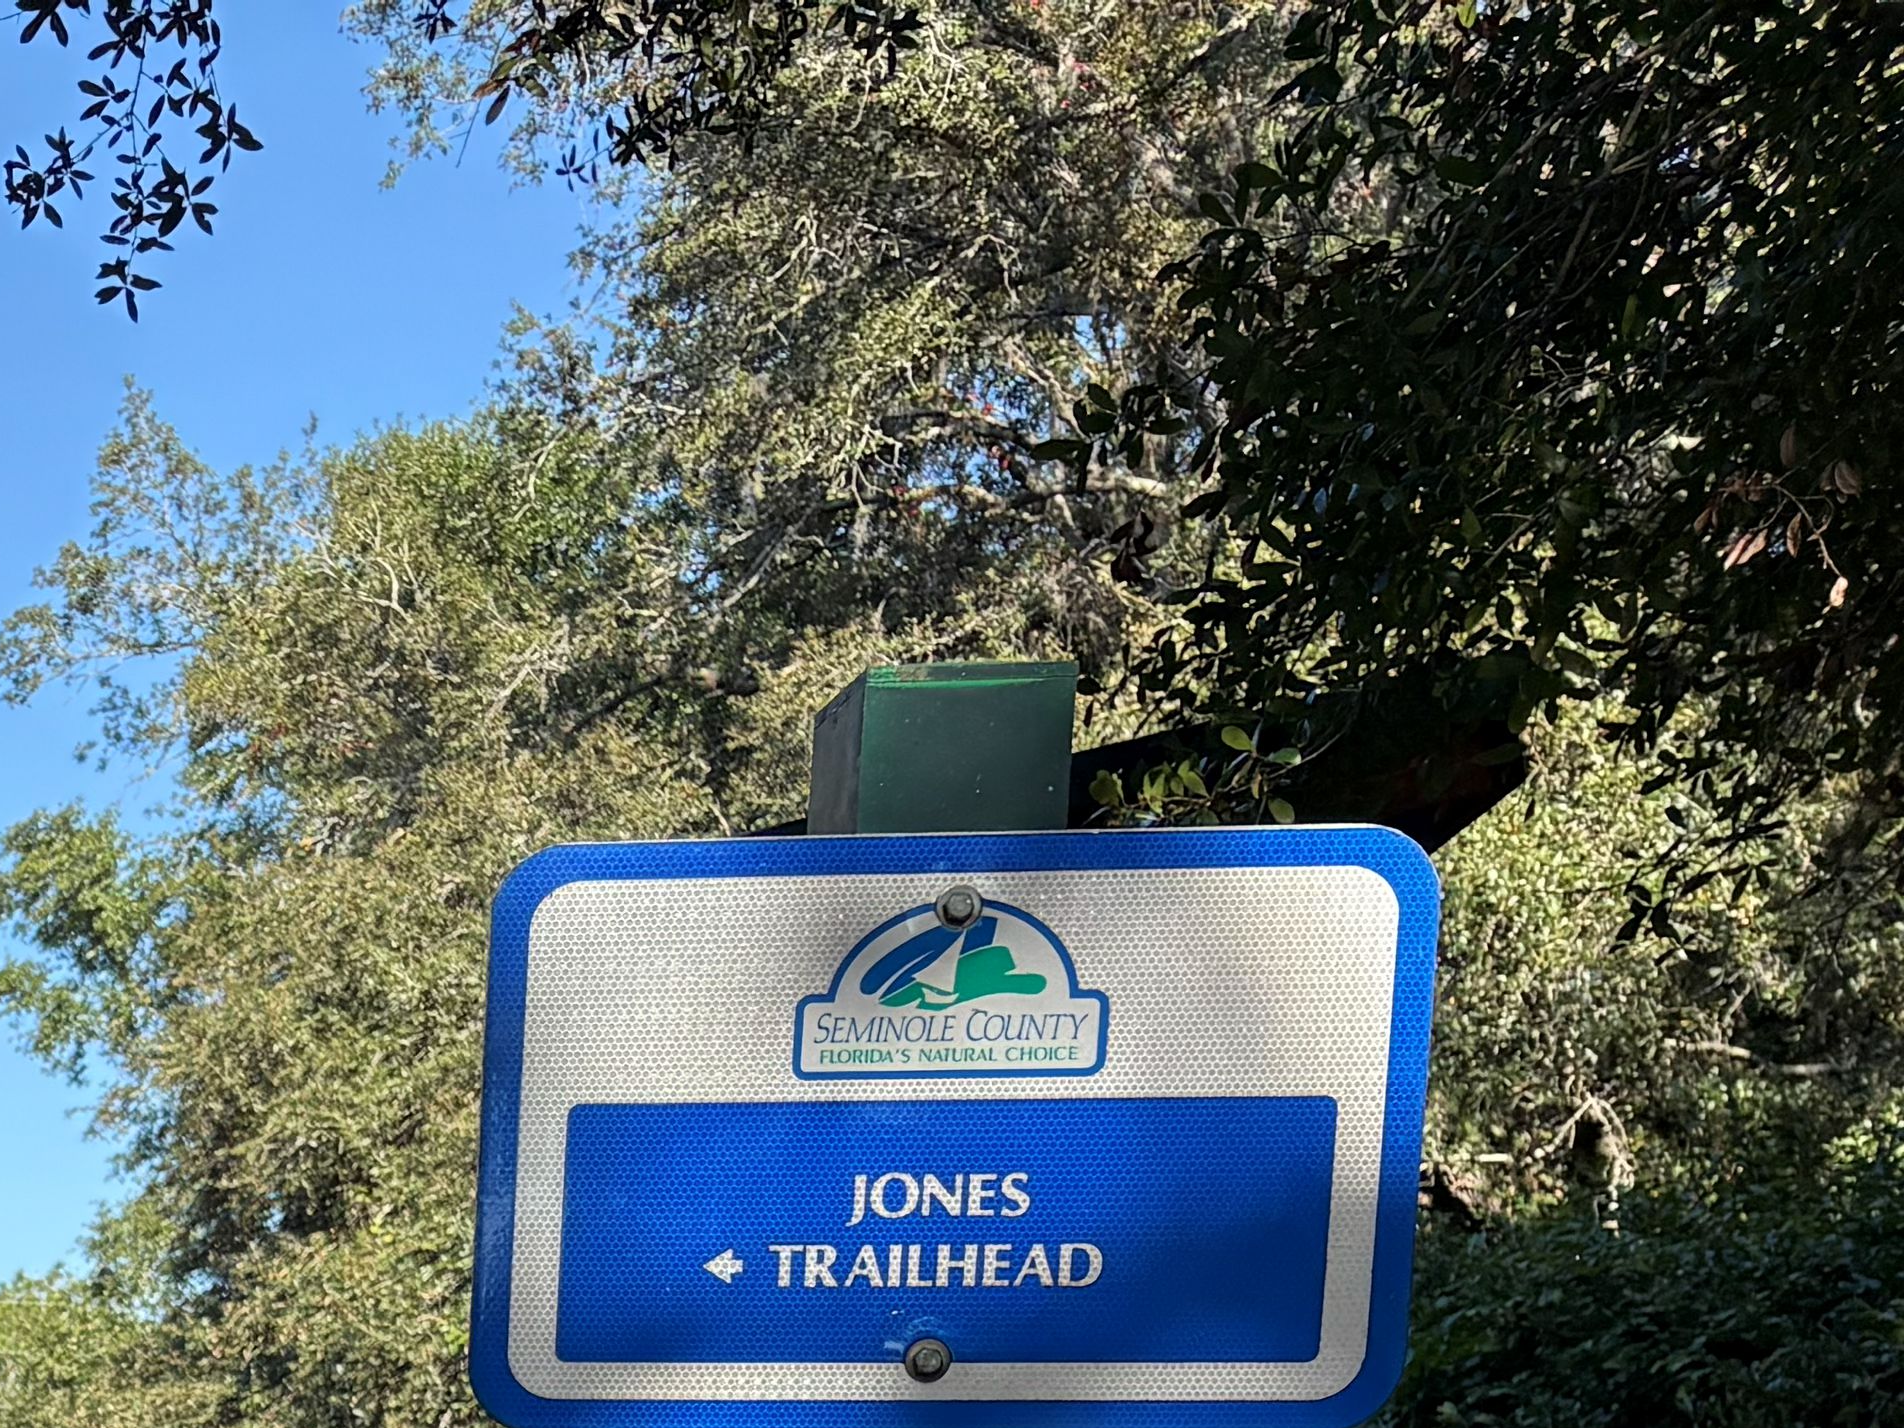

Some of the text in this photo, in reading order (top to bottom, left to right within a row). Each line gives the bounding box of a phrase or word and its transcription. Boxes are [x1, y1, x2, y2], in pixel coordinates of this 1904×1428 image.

[814, 1008, 1089, 1044] SEMINOLE COUNTY
[819, 1046, 1079, 1065] FLORIDA'S NATURAL CHOICE
[845, 1172, 1031, 1227] JONES
[768, 1242, 1104, 1288] TRAILHEAD
